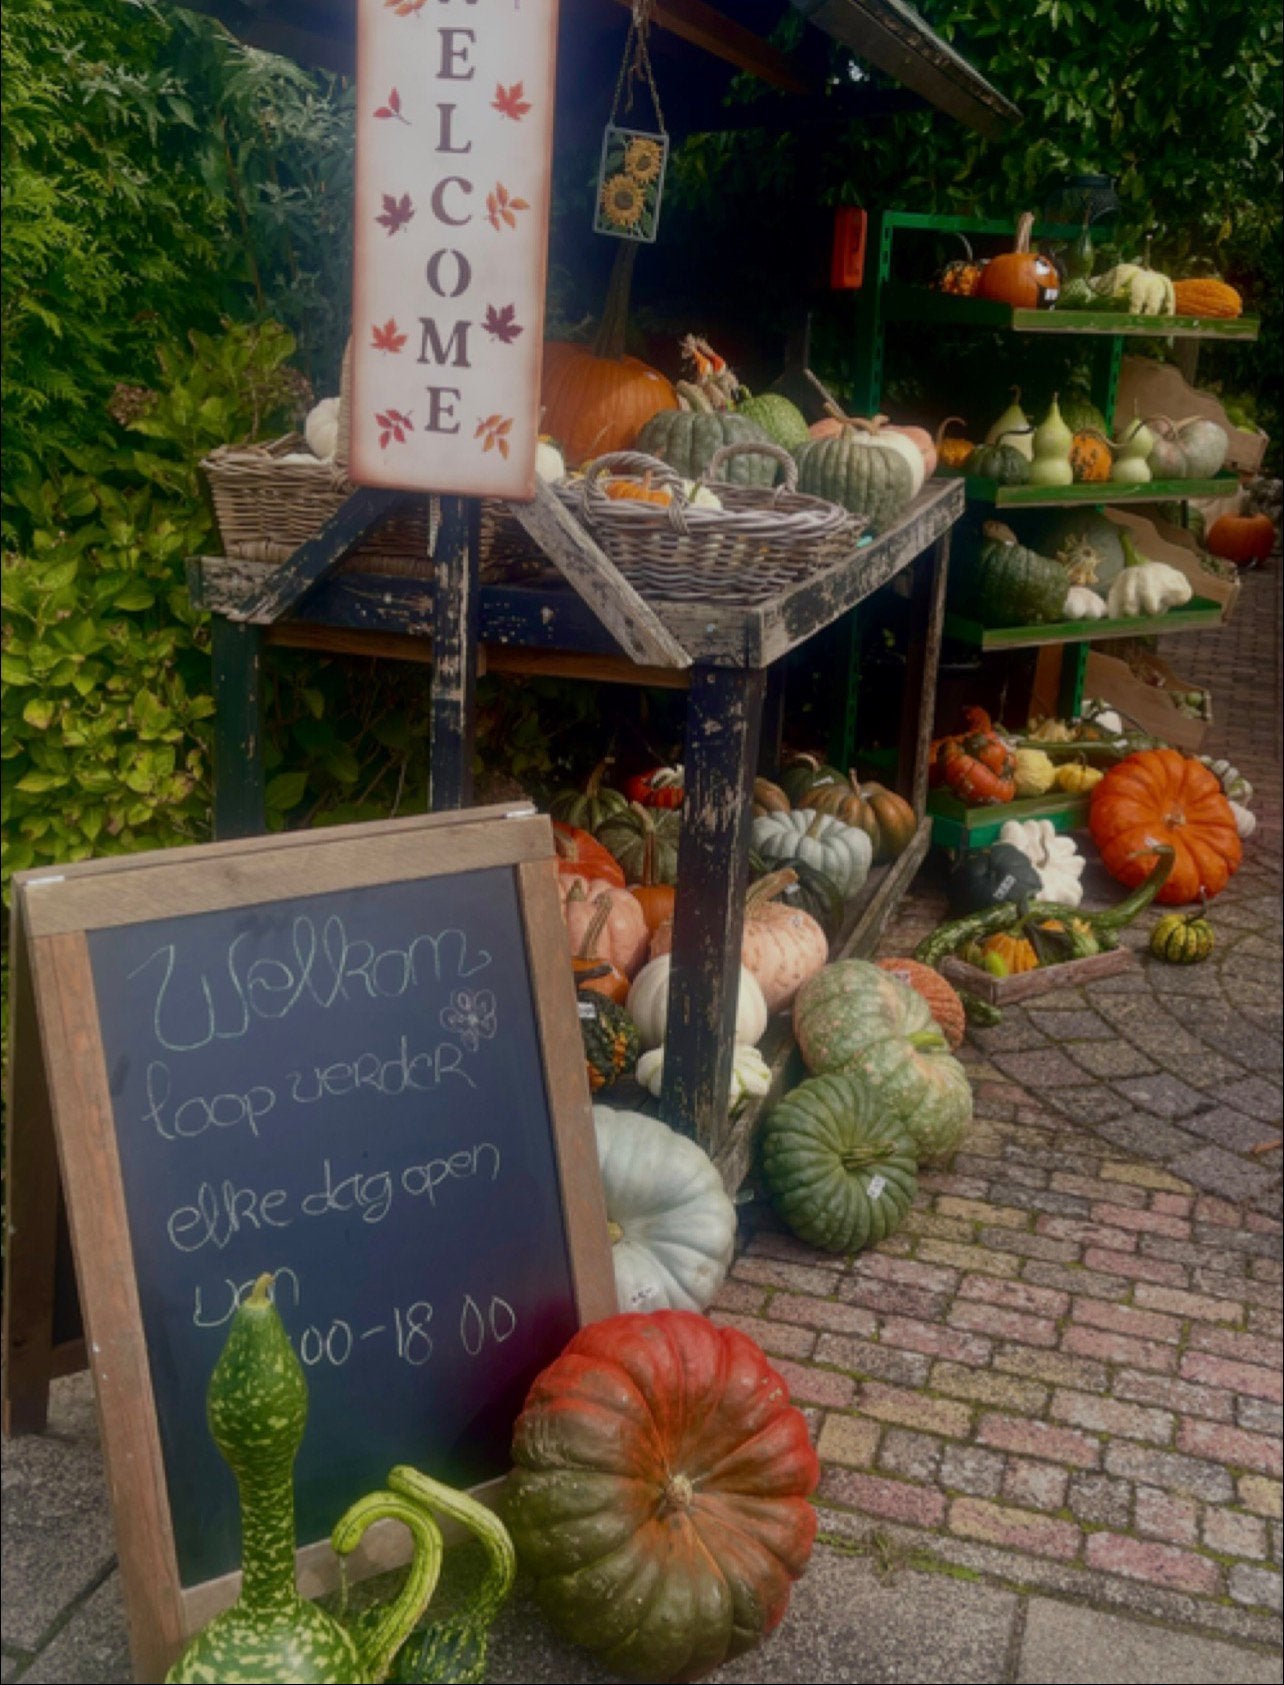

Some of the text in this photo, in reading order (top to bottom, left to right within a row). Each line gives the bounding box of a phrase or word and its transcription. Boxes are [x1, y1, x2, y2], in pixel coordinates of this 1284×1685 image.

[416, 0, 479, 436] ELCOME
[141, 1060, 277, 1141] loop
[167, 1142, 501, 1252] elke dag open
